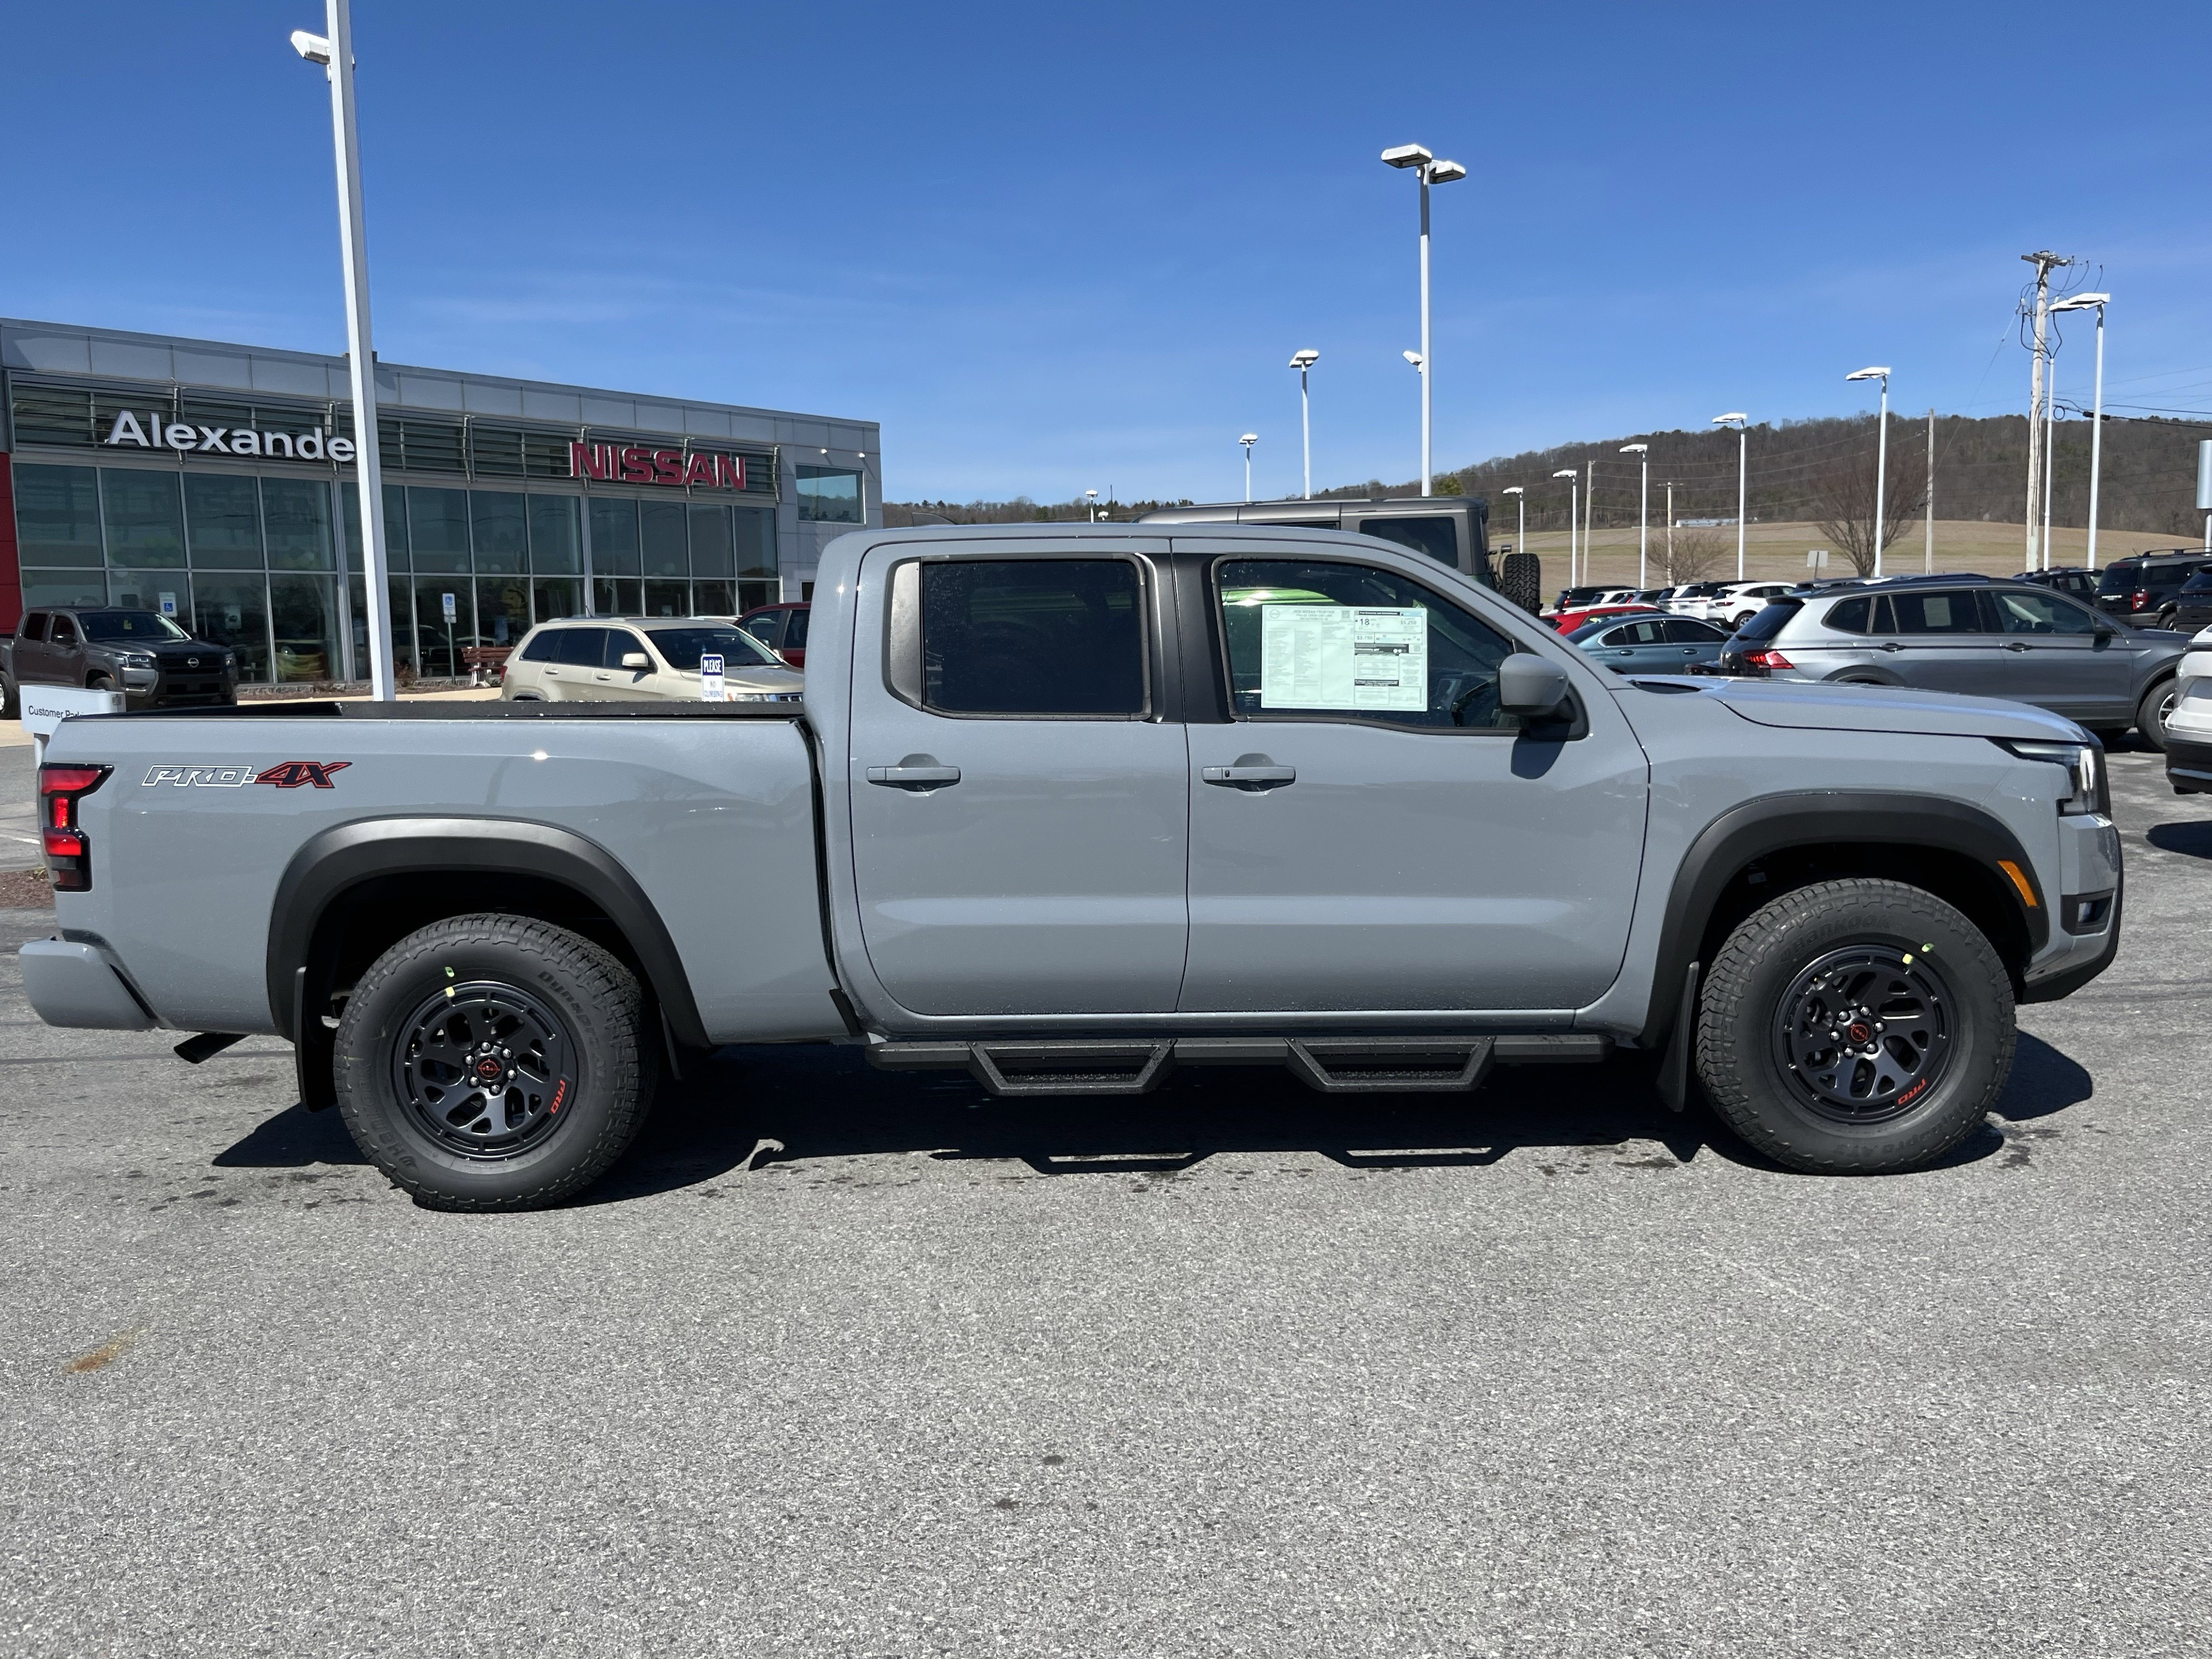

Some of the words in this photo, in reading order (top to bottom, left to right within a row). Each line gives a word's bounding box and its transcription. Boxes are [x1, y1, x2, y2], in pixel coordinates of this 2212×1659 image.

[109, 410, 356, 462] Alexande
[569, 442, 746, 489] NISSAN
[703, 659, 722, 673] PLEASE
[29, 705, 64, 718] Customer
[550, 1079, 566, 1114] PRO
[1898, 1077, 1926, 1105] PRO
